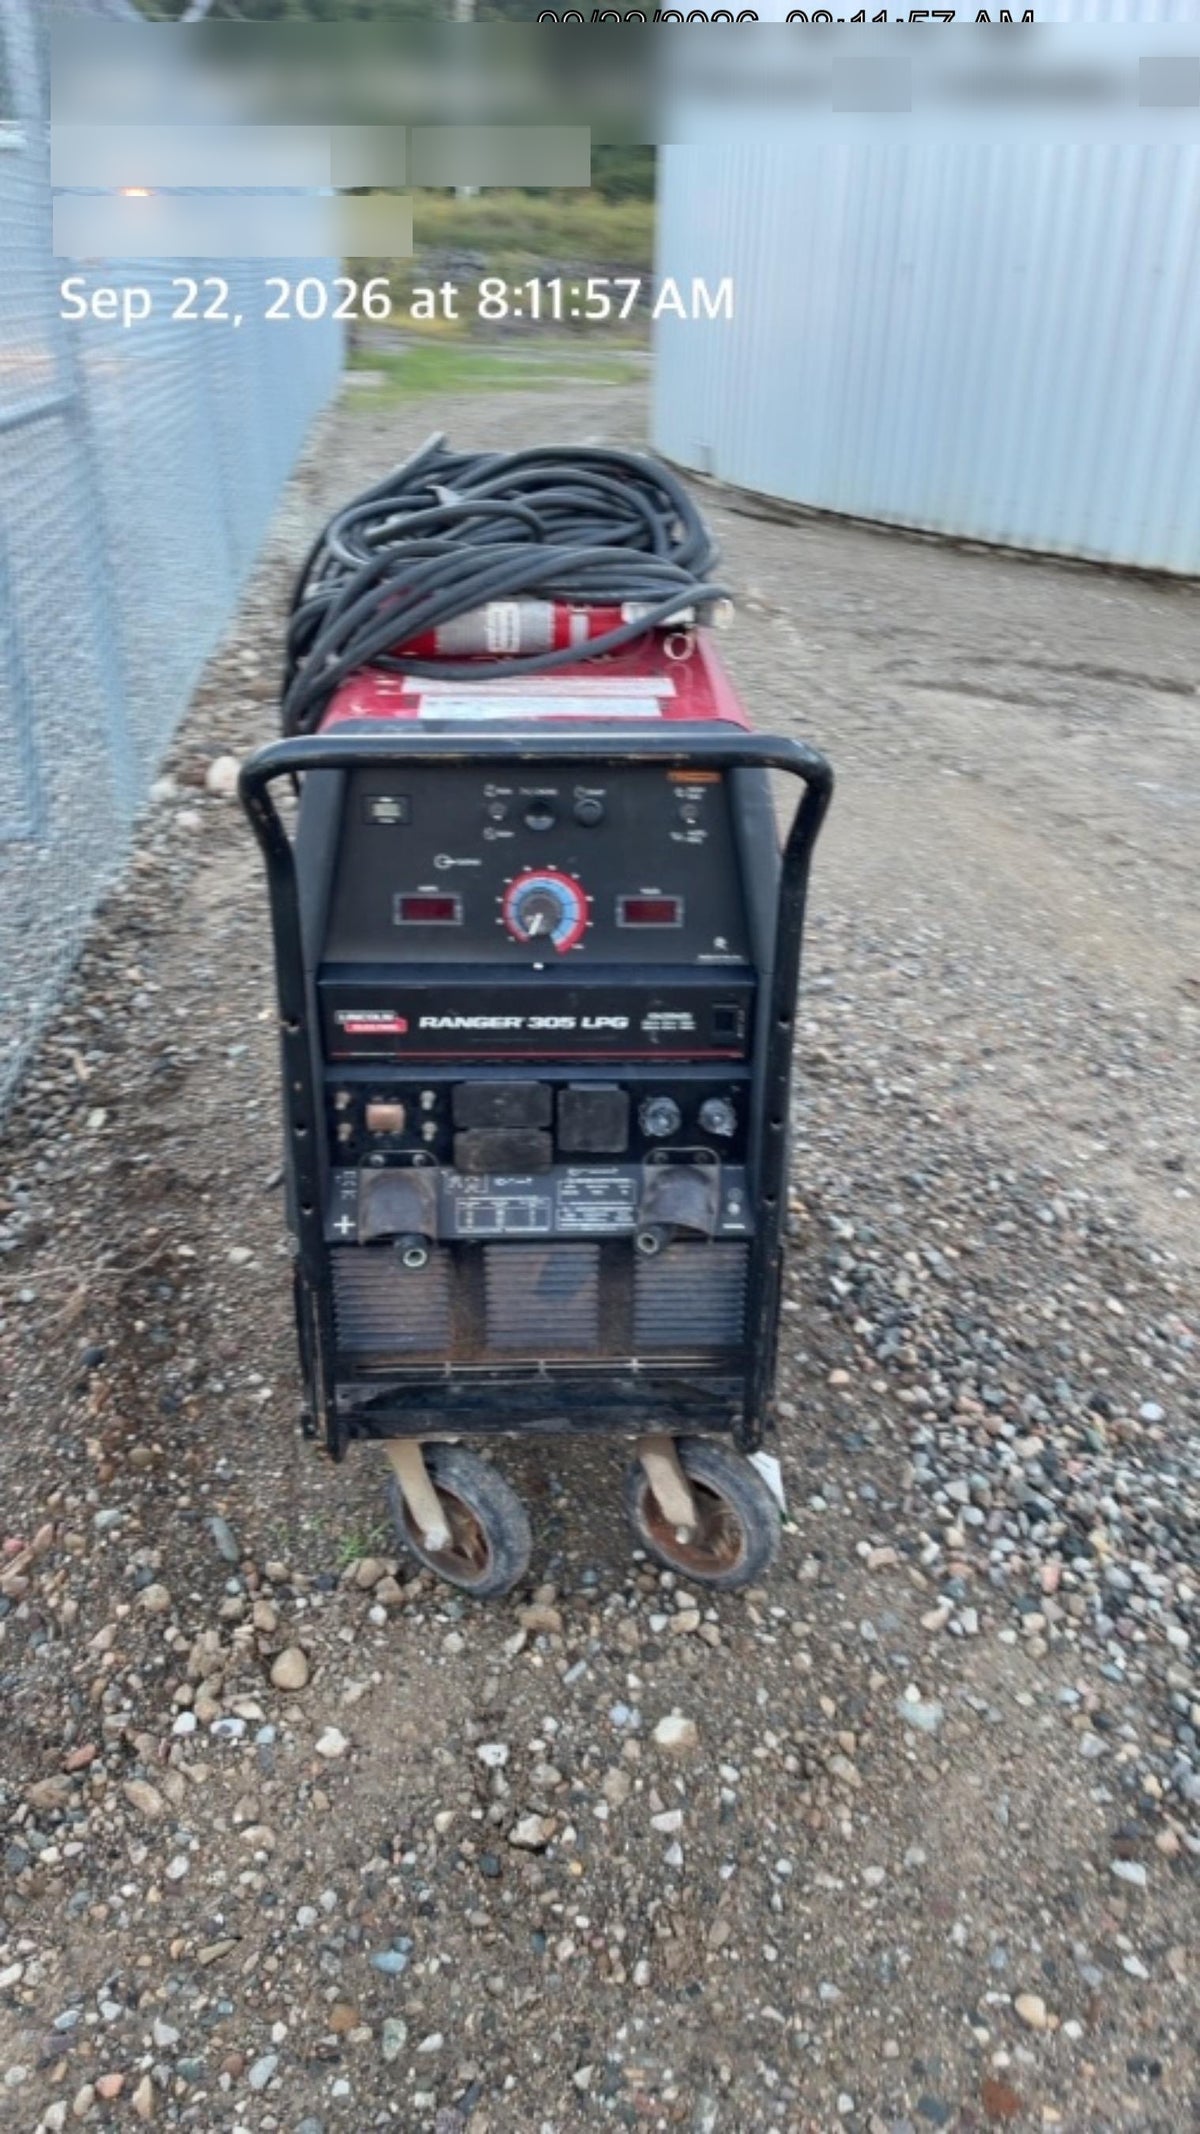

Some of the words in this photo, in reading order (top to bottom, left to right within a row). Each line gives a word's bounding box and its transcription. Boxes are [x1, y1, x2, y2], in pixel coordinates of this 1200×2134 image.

[419, 1015, 521, 1029] RANGER
[527, 1015, 576, 1029] 305
[581, 1015, 629, 1029] LPG
